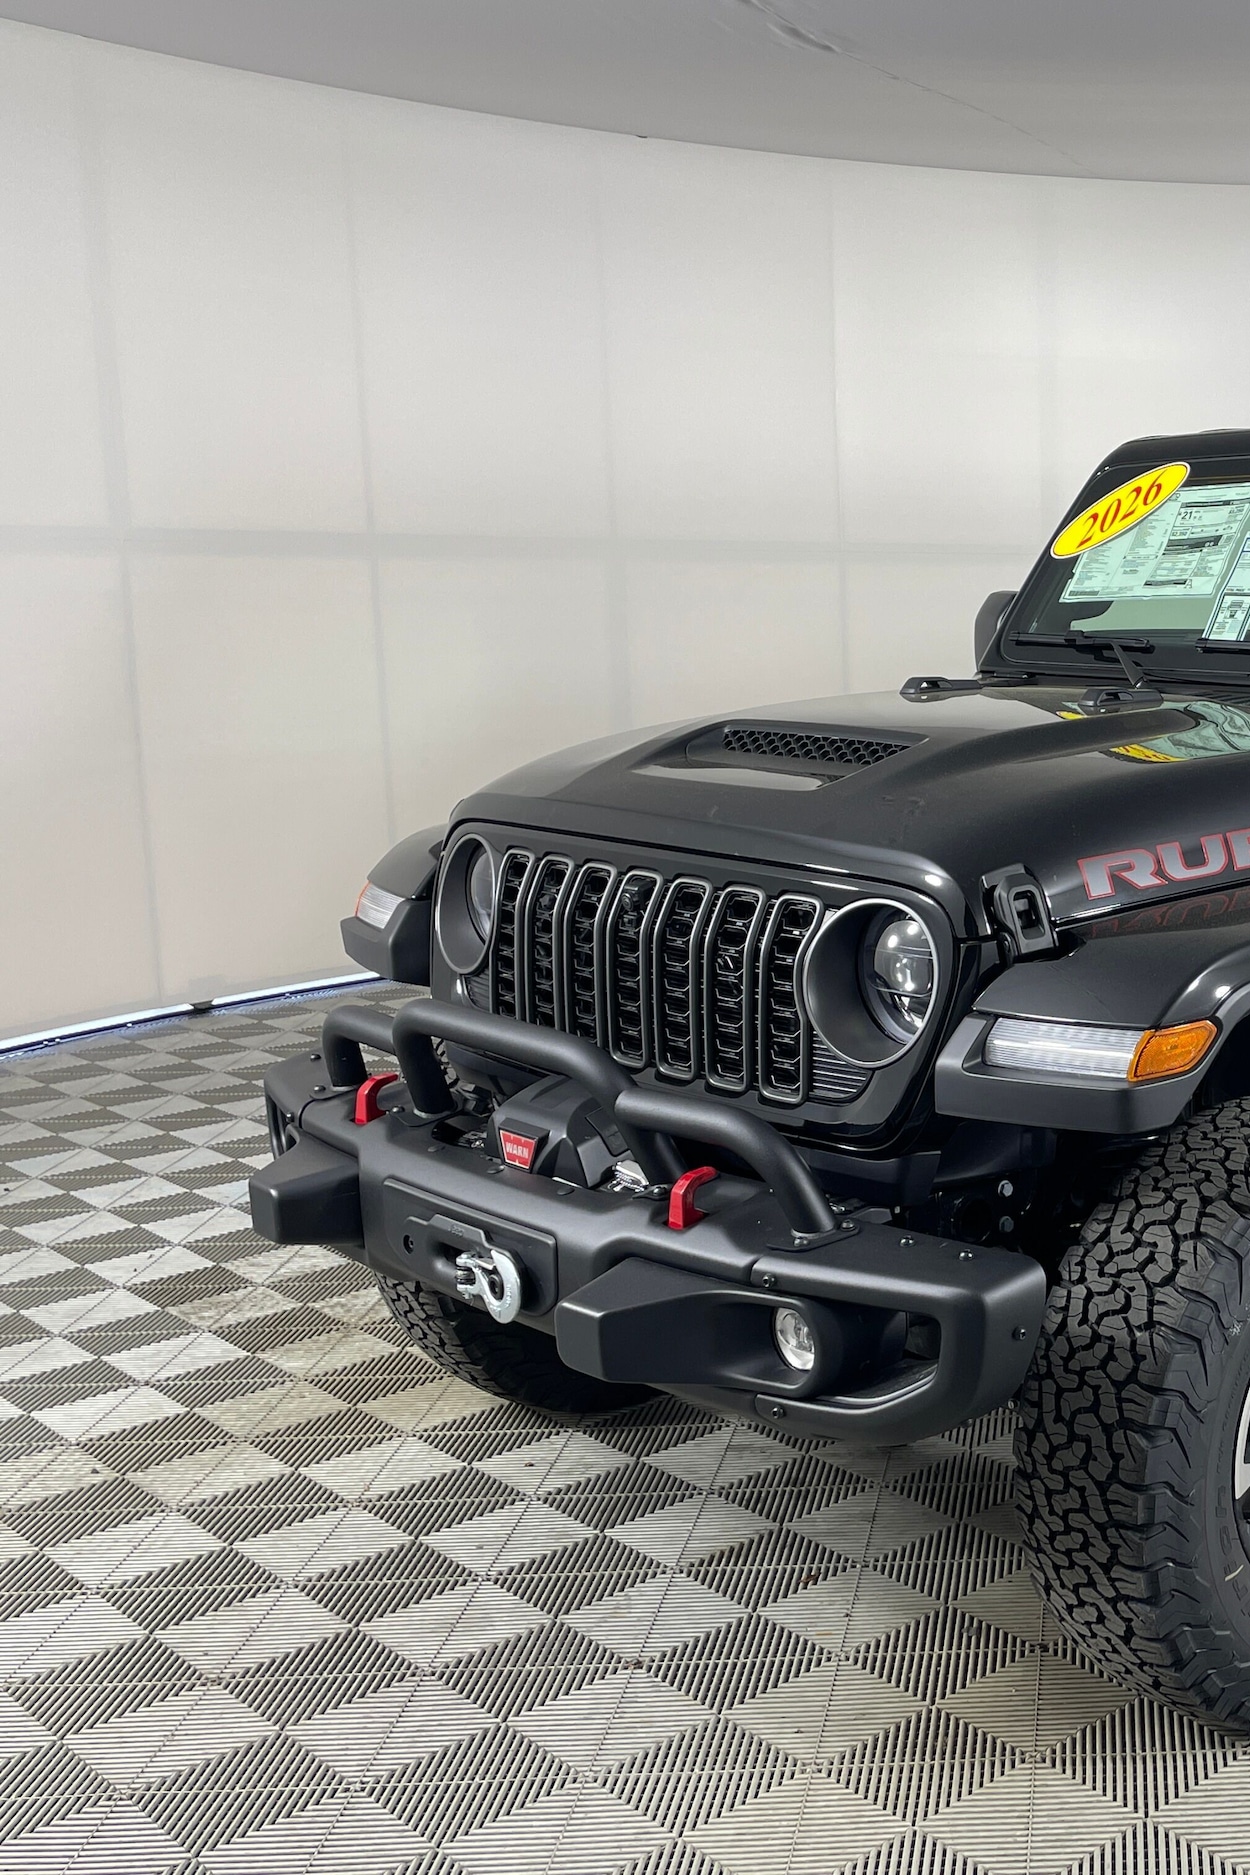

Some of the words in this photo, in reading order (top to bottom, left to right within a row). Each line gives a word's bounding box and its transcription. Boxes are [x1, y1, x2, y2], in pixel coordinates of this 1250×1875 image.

[1076, 469, 1168, 549] 2026
[1181, 511, 1193, 520] 21
[505, 1142, 529, 1159] WARN
